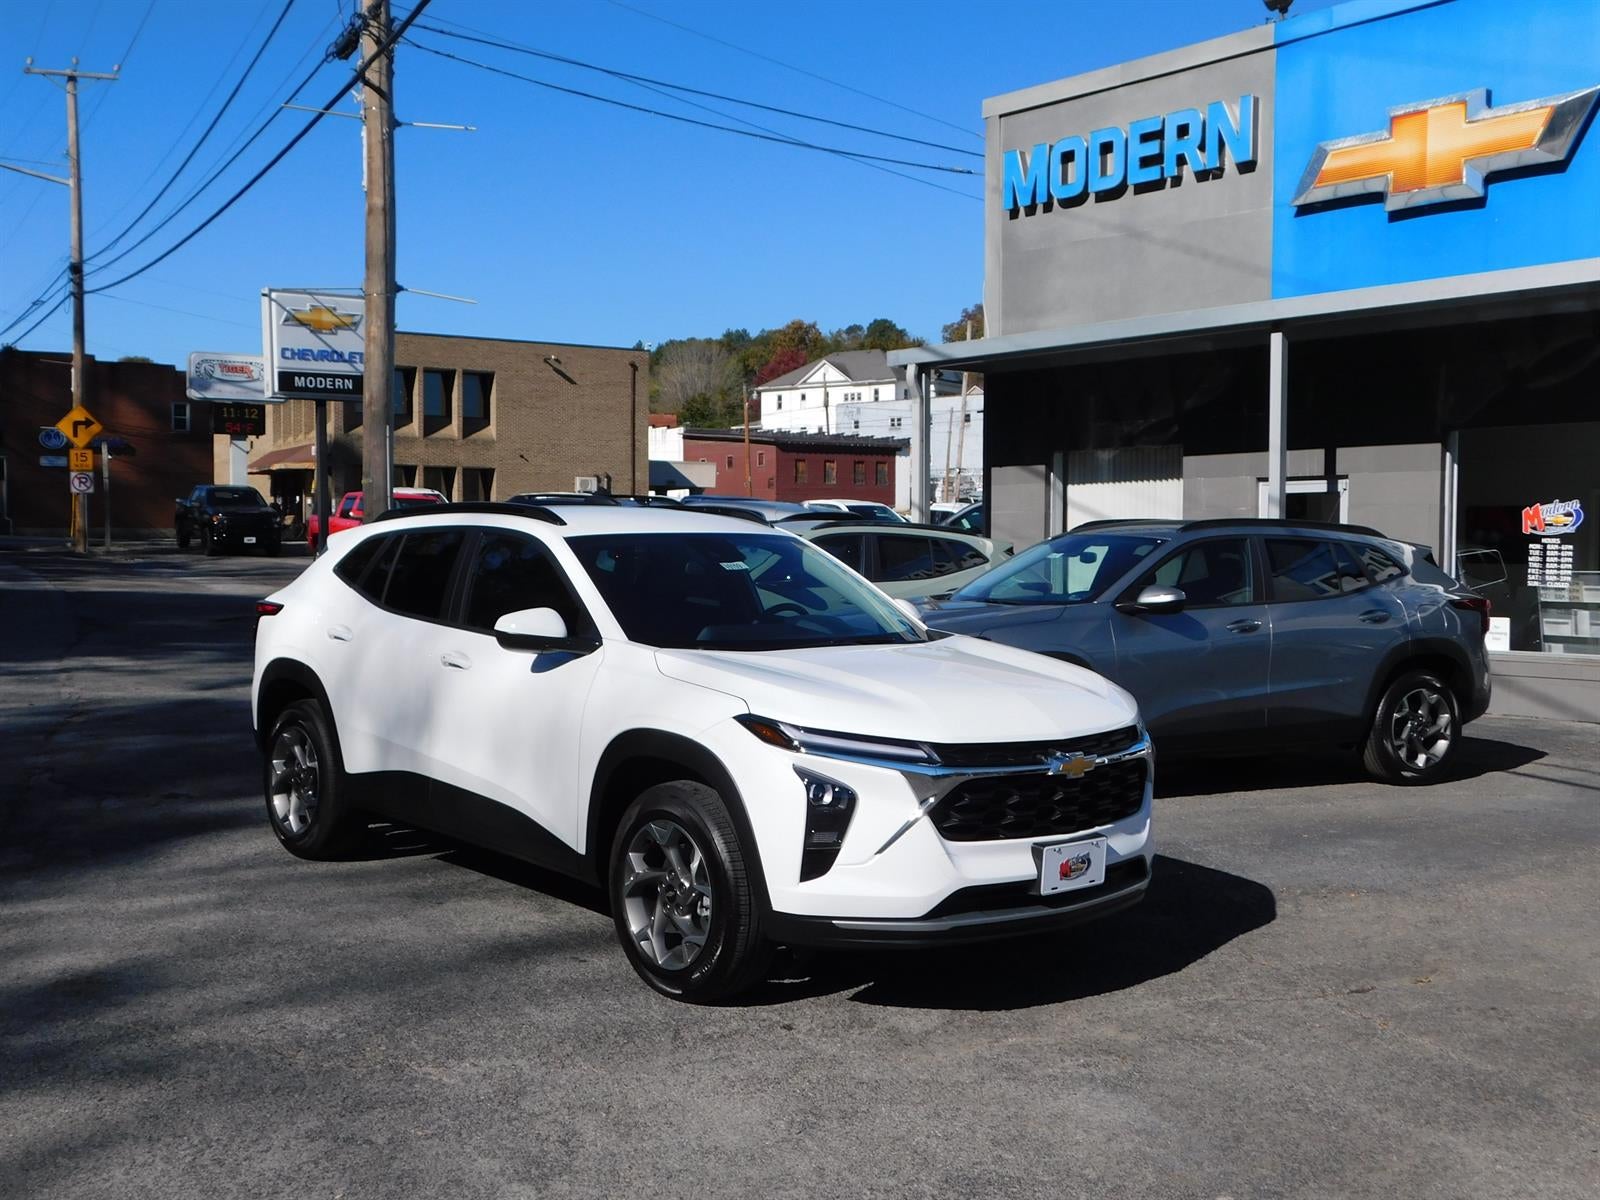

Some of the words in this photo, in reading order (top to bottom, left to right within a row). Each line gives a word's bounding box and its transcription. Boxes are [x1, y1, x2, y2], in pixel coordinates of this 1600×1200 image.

[1003, 95, 1256, 212] MODERN
[294, 376, 353, 390] MODERN
[223, 407, 258, 419] 11:12
[75, 452, 88, 463] 15
[1522, 499, 1581, 534] Modern
